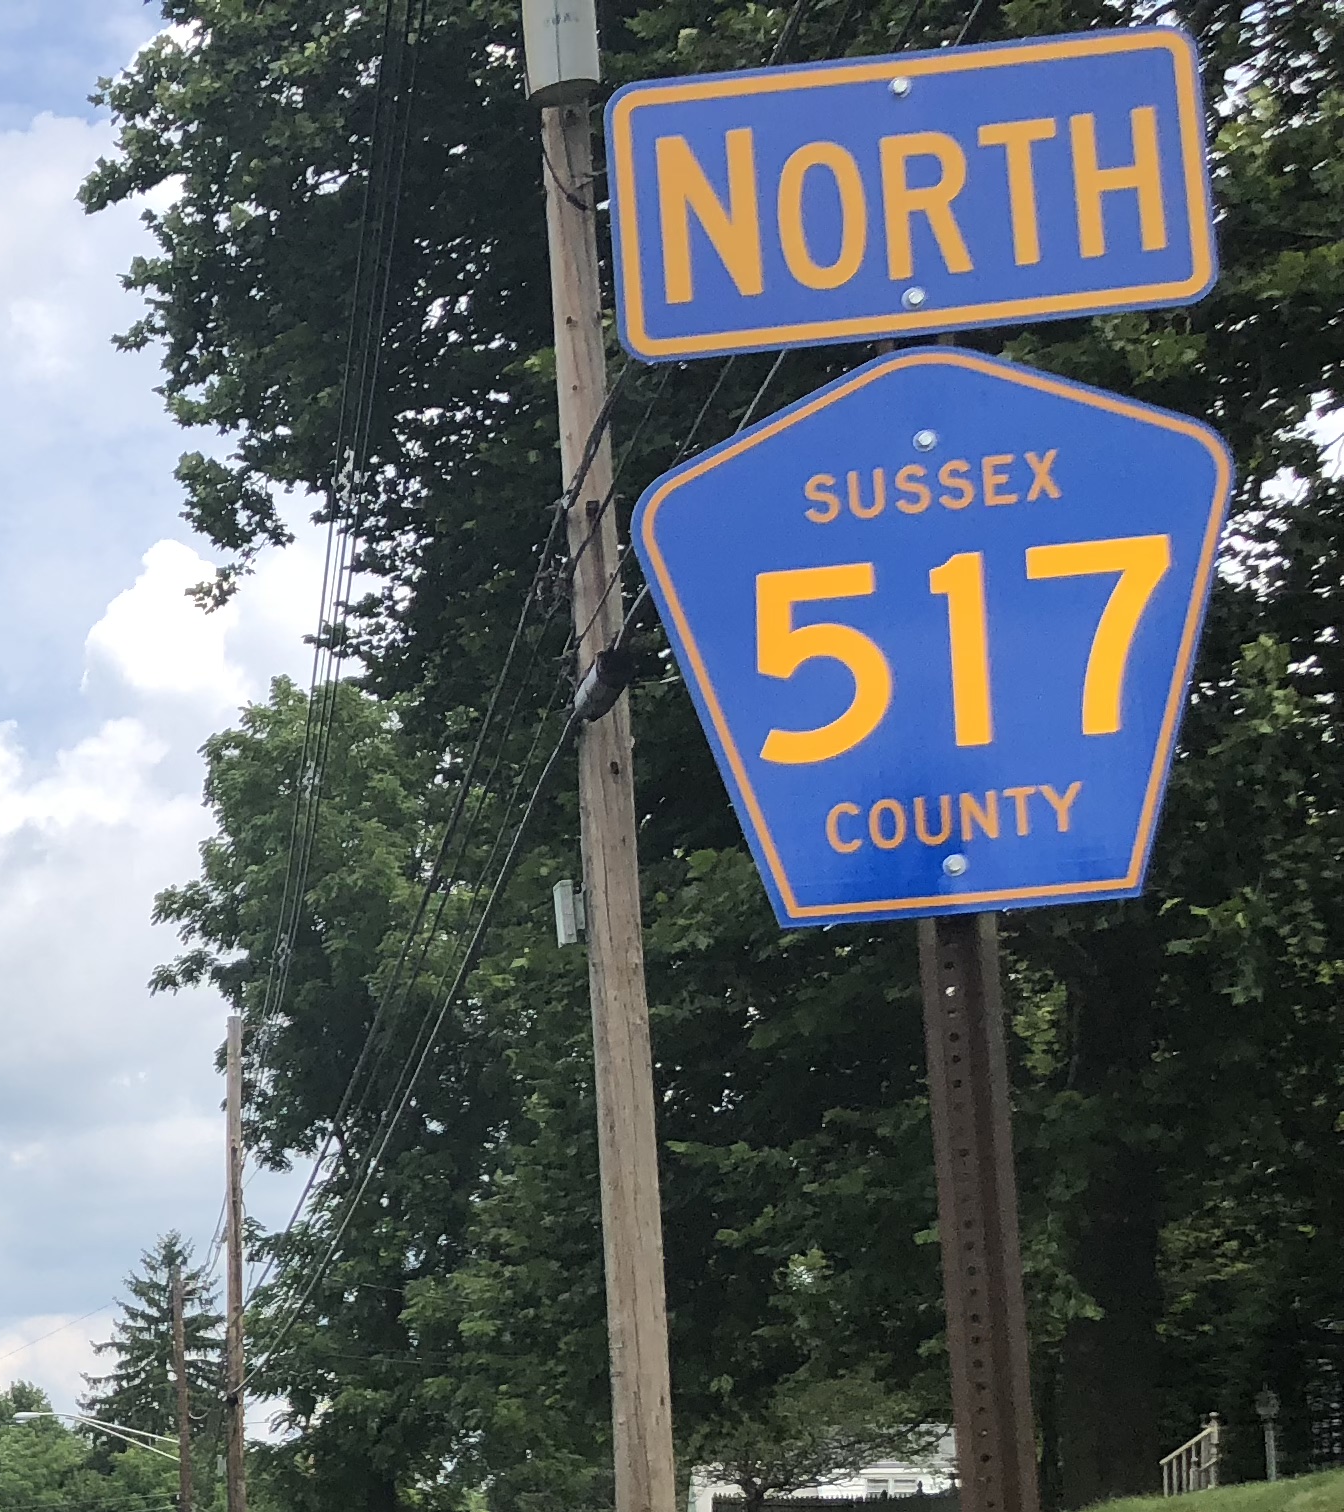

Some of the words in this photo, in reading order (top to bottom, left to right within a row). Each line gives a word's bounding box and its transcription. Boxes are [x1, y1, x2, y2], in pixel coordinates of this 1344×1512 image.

[655, 106, 1168, 305] NORTH
[804, 449, 1062, 525] SUSSEX
[755, 533, 1173, 766] 517
[825, 781, 1082, 854] COUNTY
